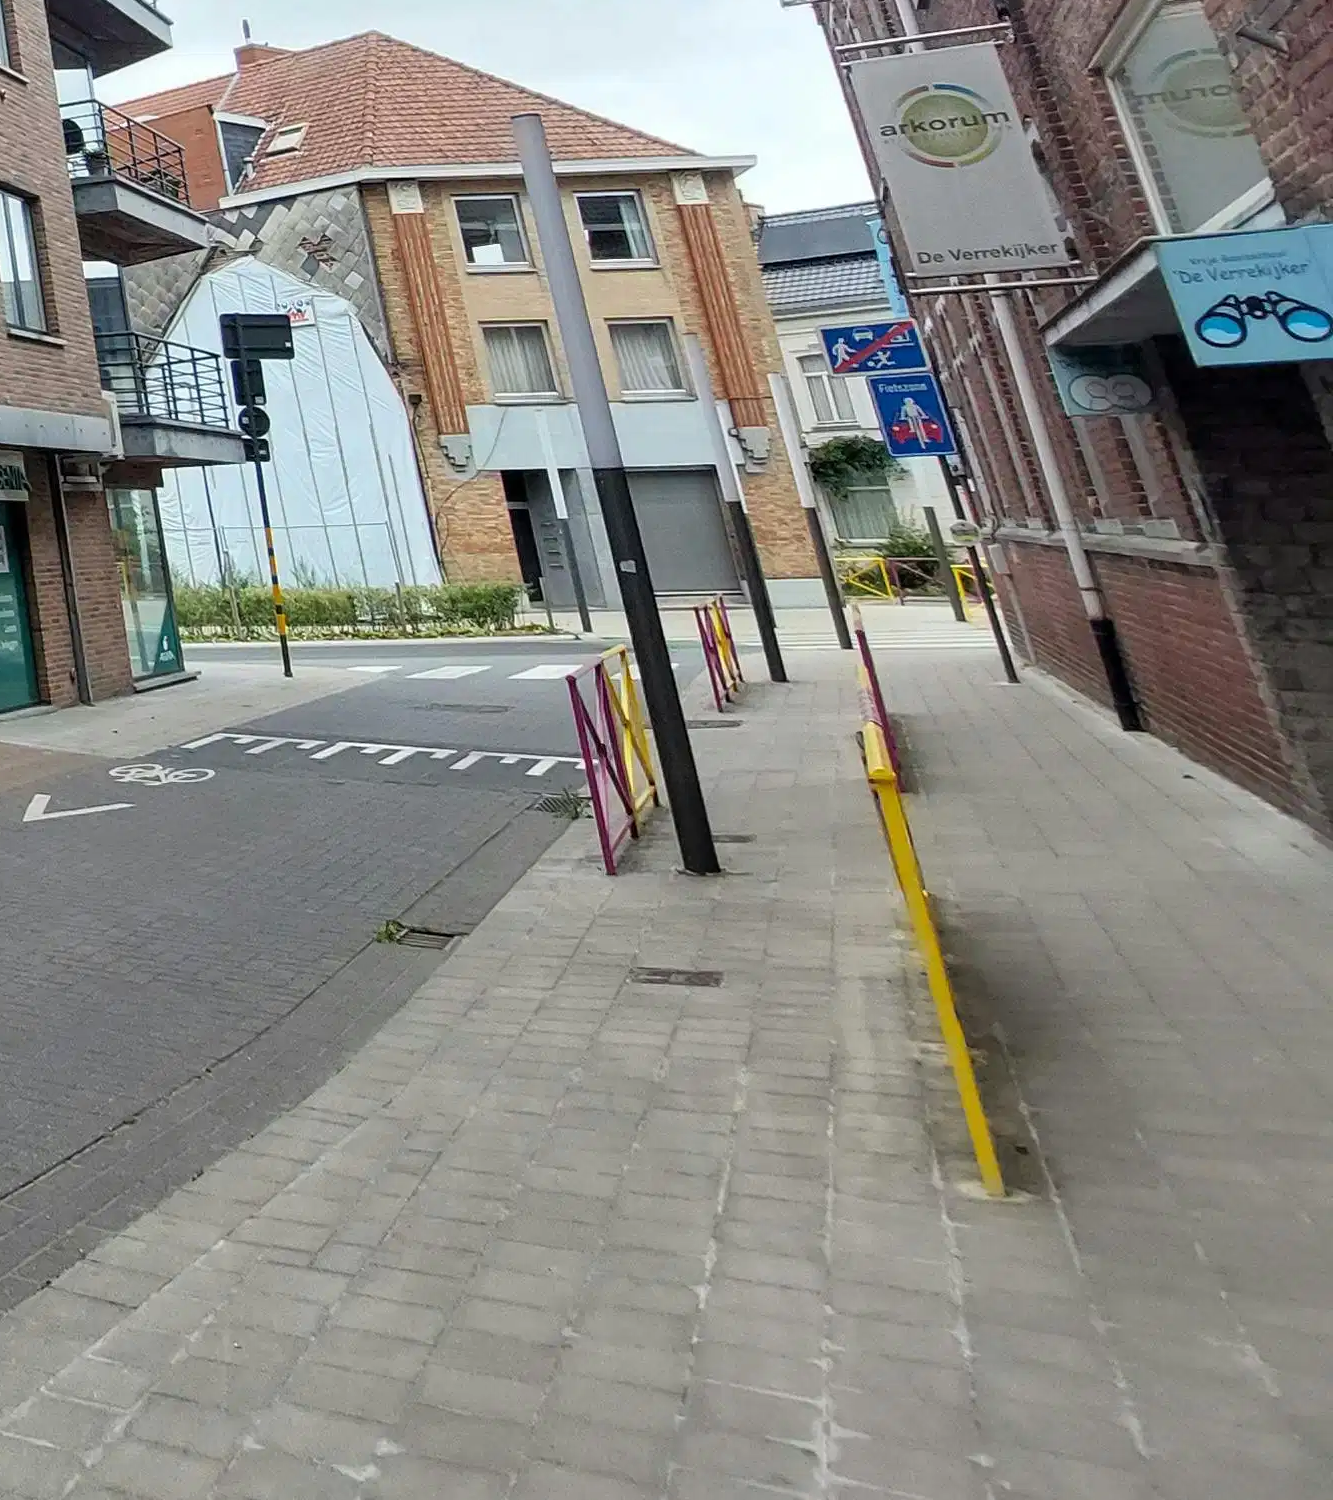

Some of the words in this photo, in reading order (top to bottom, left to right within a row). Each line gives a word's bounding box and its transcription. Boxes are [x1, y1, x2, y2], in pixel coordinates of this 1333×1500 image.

[880, 111, 1010, 137] arkorum
[917, 251, 944, 264] De
[948, 243, 1059, 261] Verrekijker
